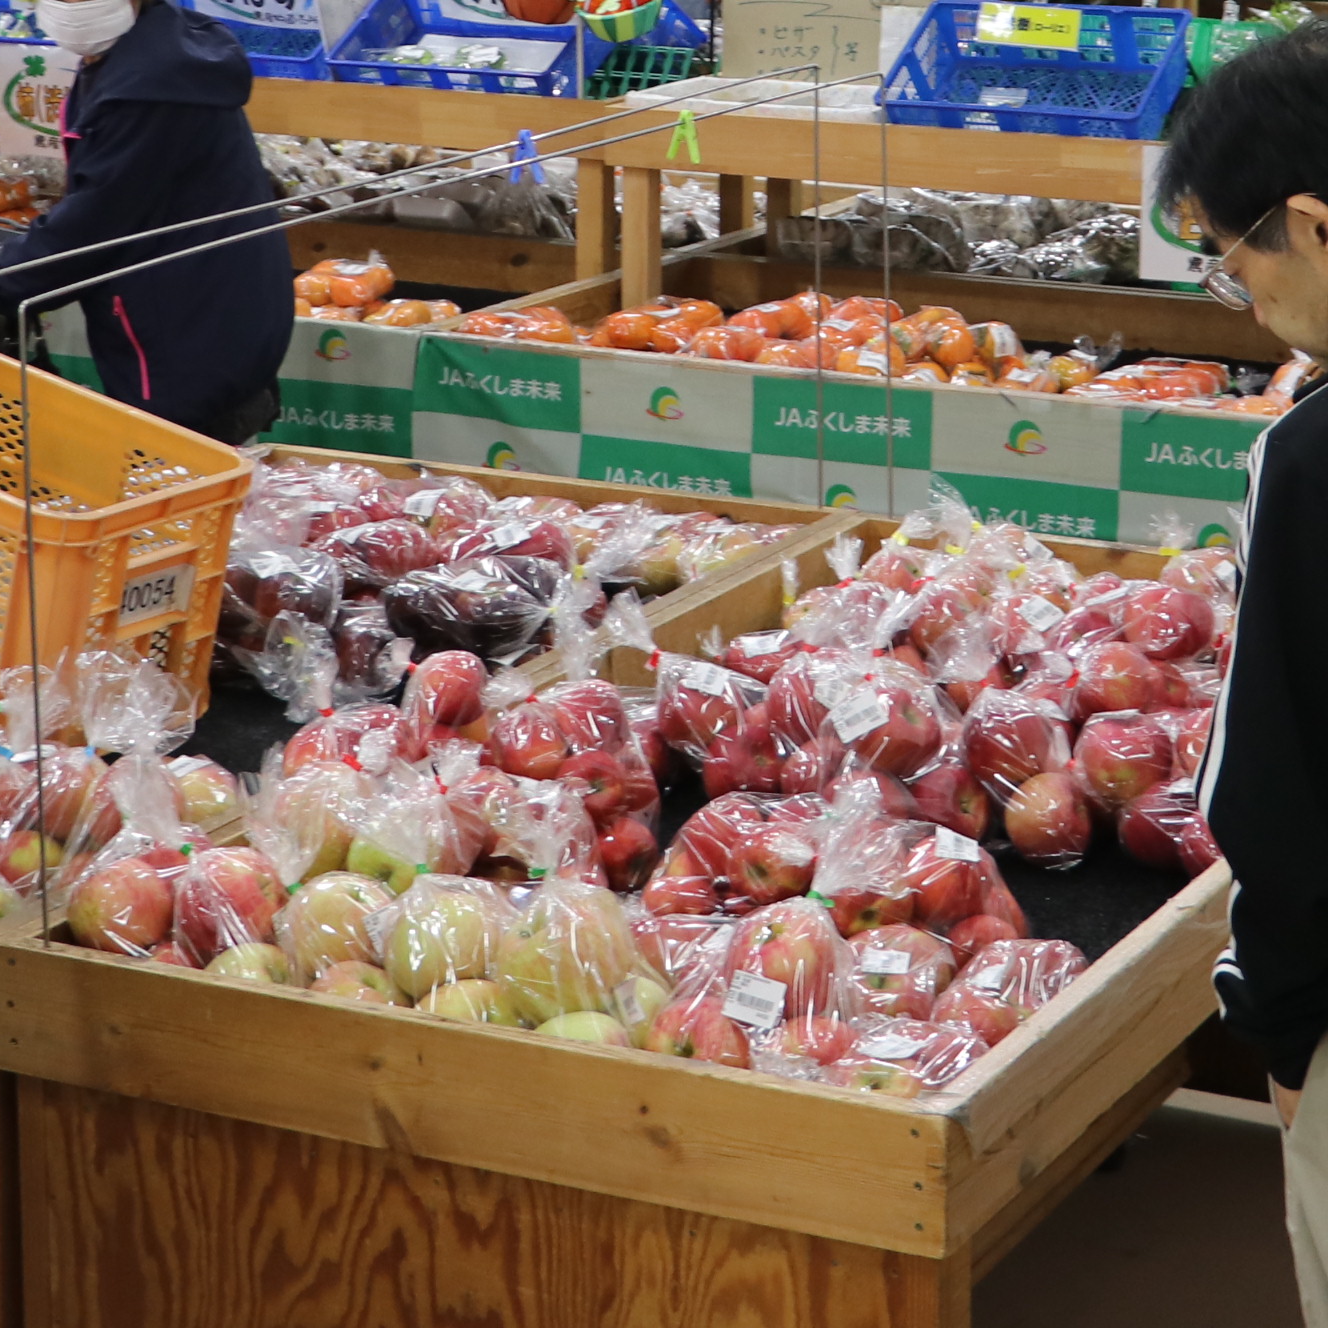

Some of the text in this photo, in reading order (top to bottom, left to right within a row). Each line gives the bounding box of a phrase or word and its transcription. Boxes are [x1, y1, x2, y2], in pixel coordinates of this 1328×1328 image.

[438, 366, 562, 401] JAふくしま未来
[775, 407, 912, 437] JAふくしま未来
[971, 504, 1096, 538] Aふくしま未来
